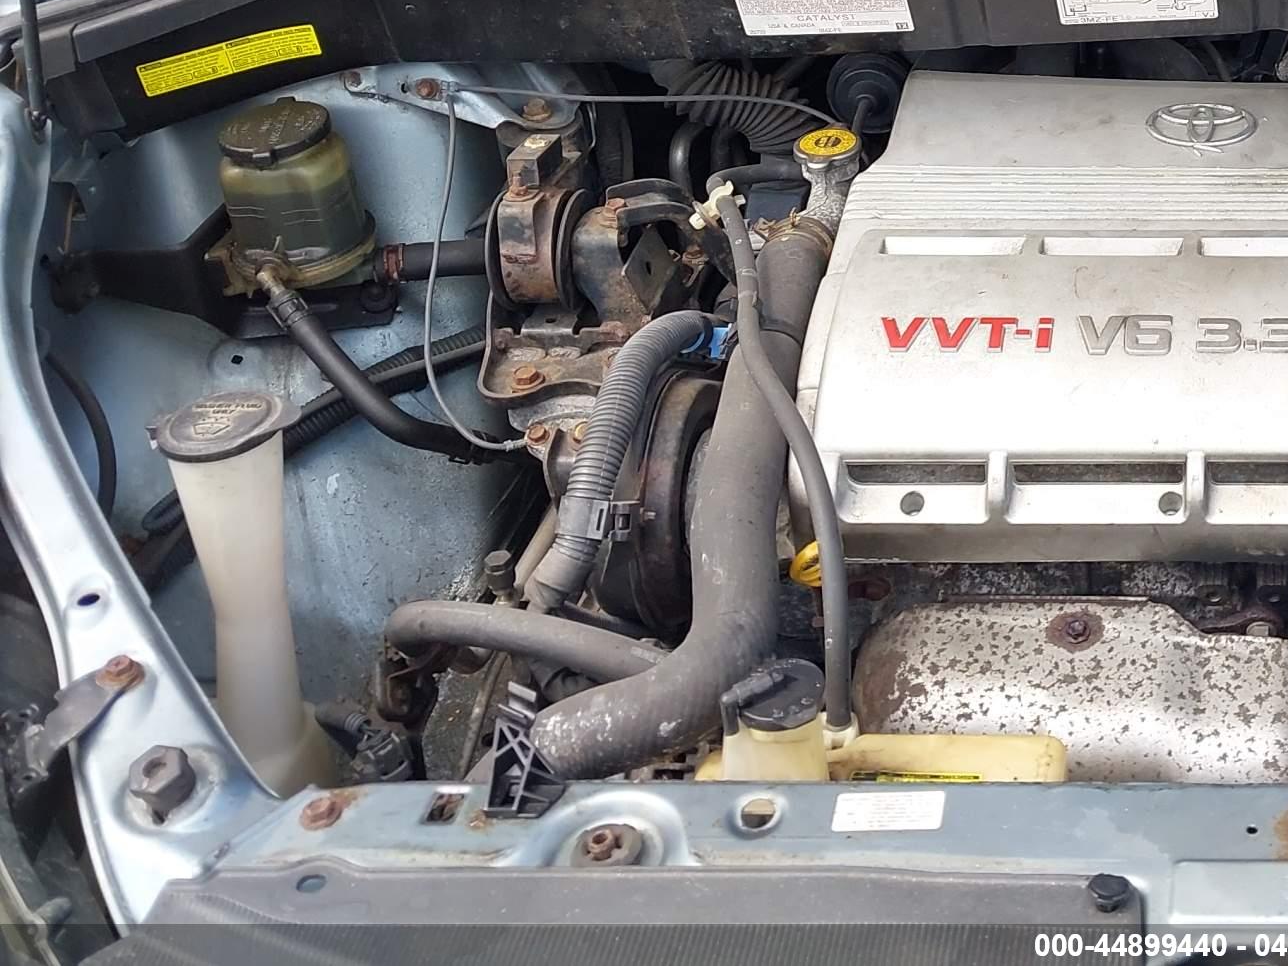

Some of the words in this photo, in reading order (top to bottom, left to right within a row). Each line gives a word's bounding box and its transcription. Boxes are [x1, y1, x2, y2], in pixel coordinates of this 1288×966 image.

[797, 13, 857, 22] CATALYST
[880, 317, 1055, 352] VVT-i
[1078, 315, 1173, 355] V6
